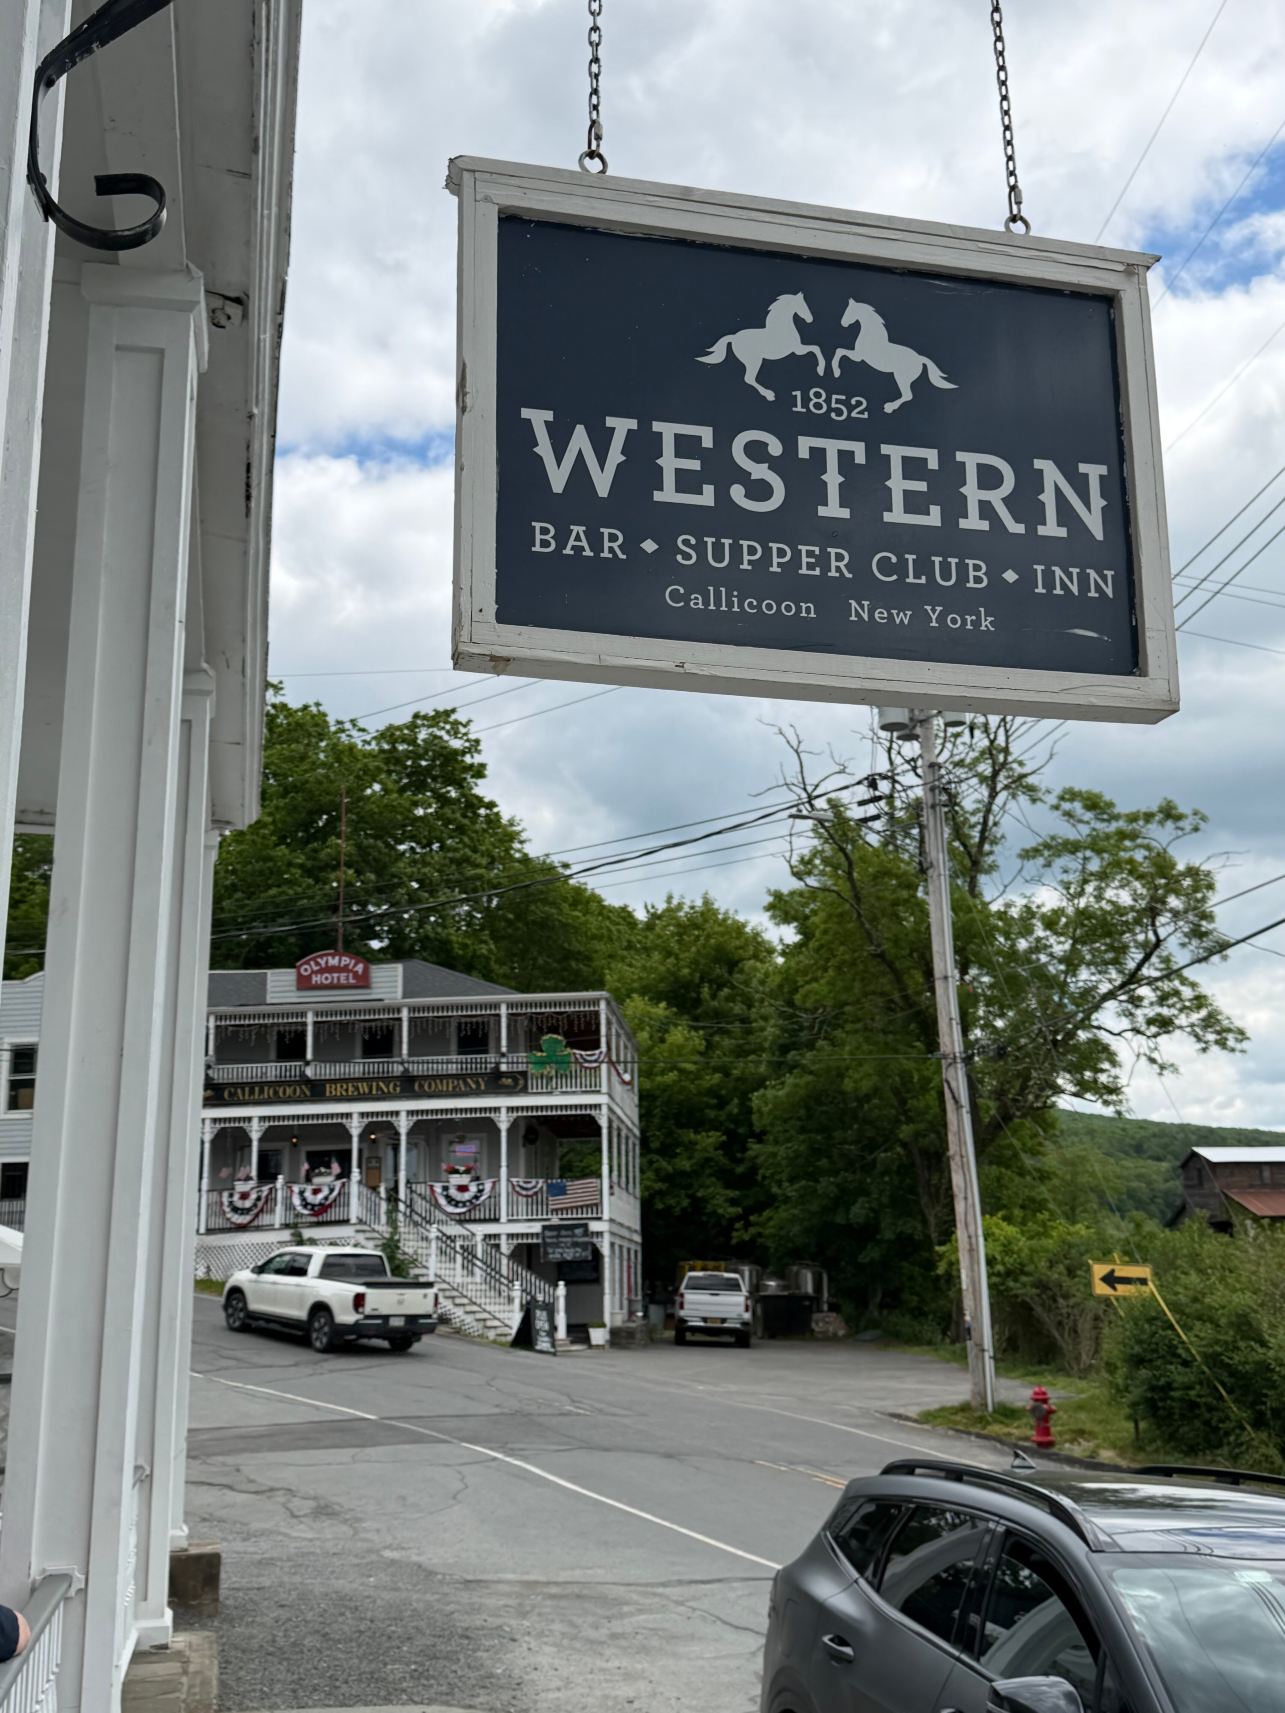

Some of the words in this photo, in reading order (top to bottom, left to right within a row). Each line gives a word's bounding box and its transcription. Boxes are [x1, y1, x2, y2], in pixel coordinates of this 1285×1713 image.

[791, 387, 869, 421] 1852
[520, 407, 1108, 541] WESTERN
[531, 521, 627, 560] BAR
[676, 534, 853, 579] SUPPER
[871, 551, 989, 589] CLUB
[1033, 564, 1115, 600] INN
[665, 585, 817, 618] Callicoon
[848, 600, 912, 625] New
[924, 605, 996, 632] York
[300, 955, 364, 976] OLYMPIA
[311, 972, 356, 985] HOTEL
[223, 1084, 312, 1101] CALLICOON
[325, 1079, 401, 1097] BREWING
[414, 1076, 488, 1093] COMPANY
